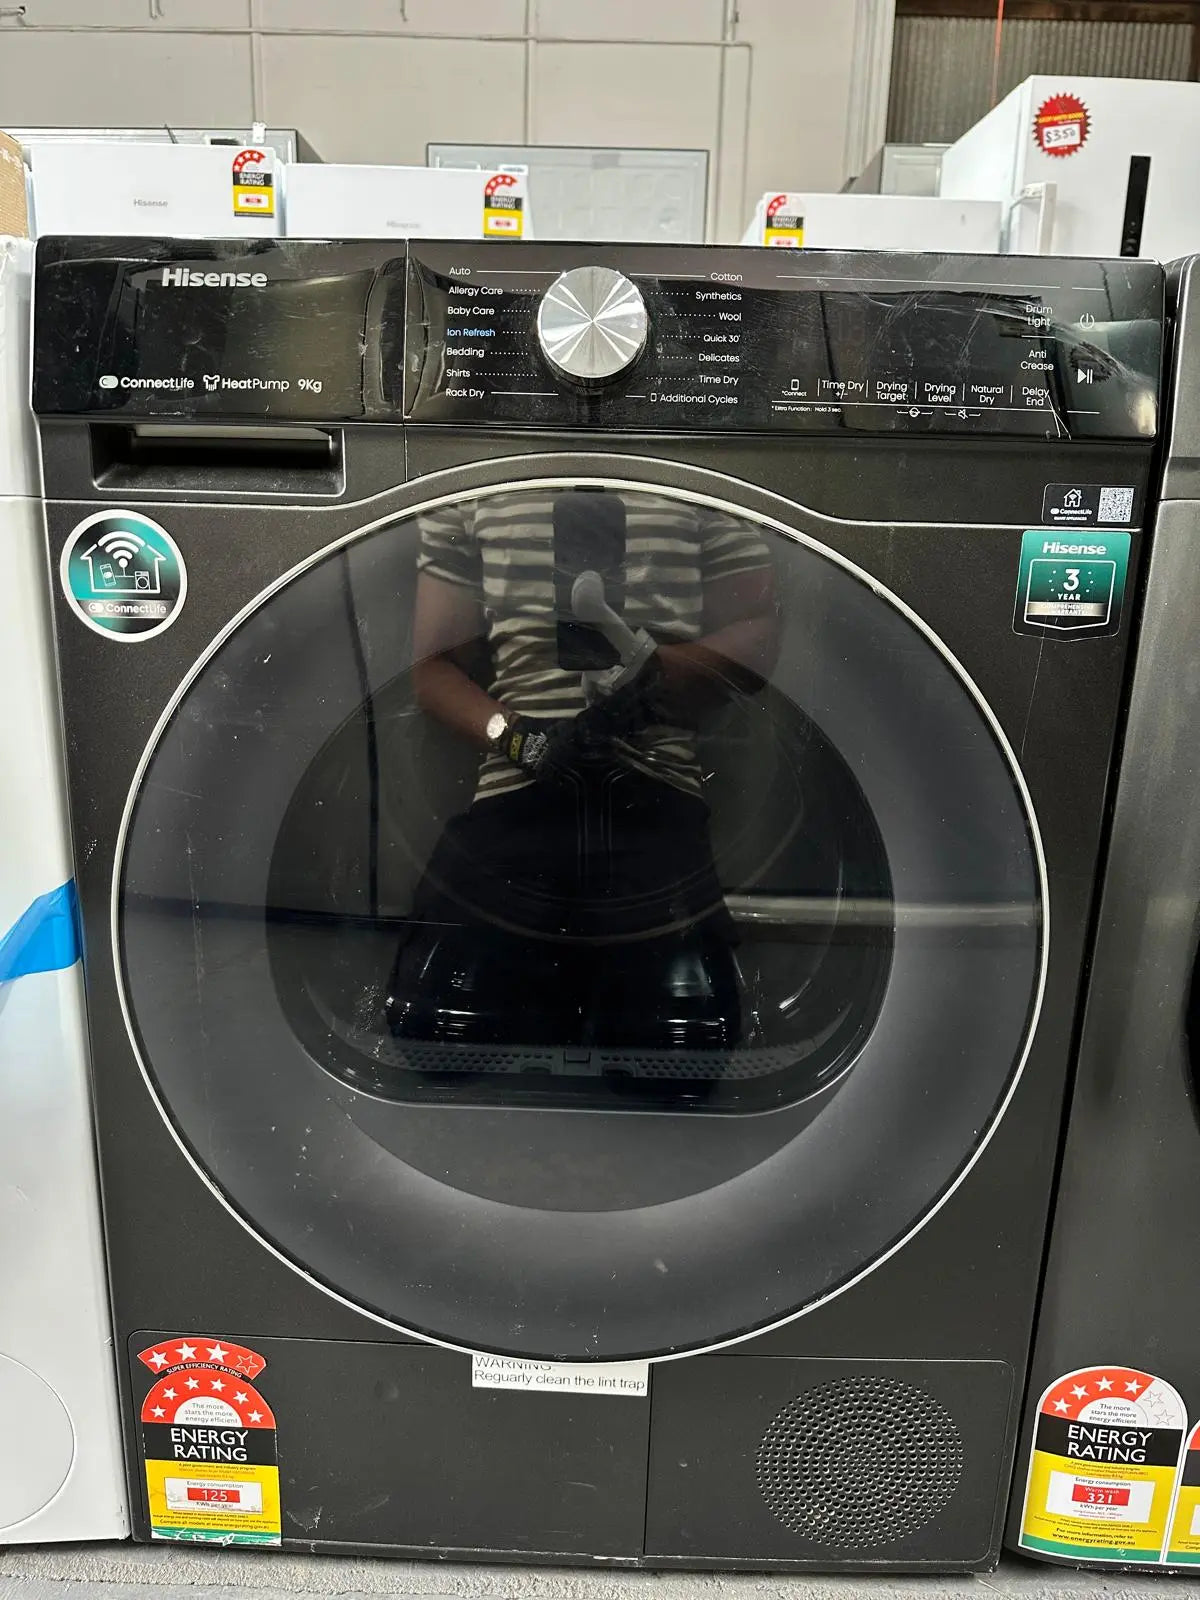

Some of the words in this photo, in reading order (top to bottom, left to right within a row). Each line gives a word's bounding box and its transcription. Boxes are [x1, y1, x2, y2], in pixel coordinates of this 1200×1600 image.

[449, 267, 471, 275] Auto
[710, 272, 743, 281] Cotton
[162, 268, 268, 287] Hisense
[448, 286, 480, 296] Allergy
[480, 287, 503, 295] Care
[696, 291, 742, 301] Synthetics
[448, 306, 471, 316] Baby
[472, 307, 494, 315] Care
[1026, 305, 1052, 314] Drum
[719, 313, 742, 321] Wool
[1028, 316, 1051, 327] Light
[447, 328, 462, 336] Ion
[463, 328, 496, 336] Refresh
[704, 334, 728, 342] Quick
[446, 348, 485, 358] Bedding
[698, 354, 740, 362] Delicates
[1028, 350, 1046, 359] Anti
[1020, 362, 1054, 371] Crease
[446, 369, 470, 377] Shirts
[120, 377, 194, 390] ConnectLife
[222, 378, 290, 393] HeatPump
[298, 379, 322, 393] 9Kg
[700, 375, 721, 384] Time
[724, 376, 738, 386] Dry
[822, 380, 846, 390] Time
[848, 381, 864, 392] Dry
[876, 381, 908, 392] Drying
[924, 383, 956, 395] Drying
[971, 385, 1004, 394] Natural
[1022, 386, 1050, 397] Delay
[446, 388, 468, 396] Rack
[469, 390, 485, 400] Dry
[660, 394, 706, 403] Additional
[708, 395, 738, 405] Cycles
[876, 391, 906, 402] Target
[928, 394, 952, 403] Level
[980, 394, 994, 405] Dry
[1026, 397, 1044, 406] End
[1042, 542, 1107, 555] Hisense
[1063, 568, 1080, 590] 3
[106, 604, 166, 614] ConnectLife
[166, 1365, 186, 1374] SUPER
[186, 1362, 218, 1370] EFFICIENCY
[220, 1366, 242, 1378] RATING
[474, 1370, 532, 1386] Reguarly
[536, 1372, 570, 1384] clean
[574, 1376, 594, 1386] the
[598, 1376, 616, 1388] lint
[620, 1378, 645, 1391] trap
[170, 1428, 248, 1446] ENERGY
[1068, 1424, 1152, 1447] ENERGY
[174, 1444, 248, 1461] RATING
[1068, 1442, 1146, 1463] RATING
[202, 1490, 228, 1500] 125
[1087, 1492, 1112, 1504] 321
